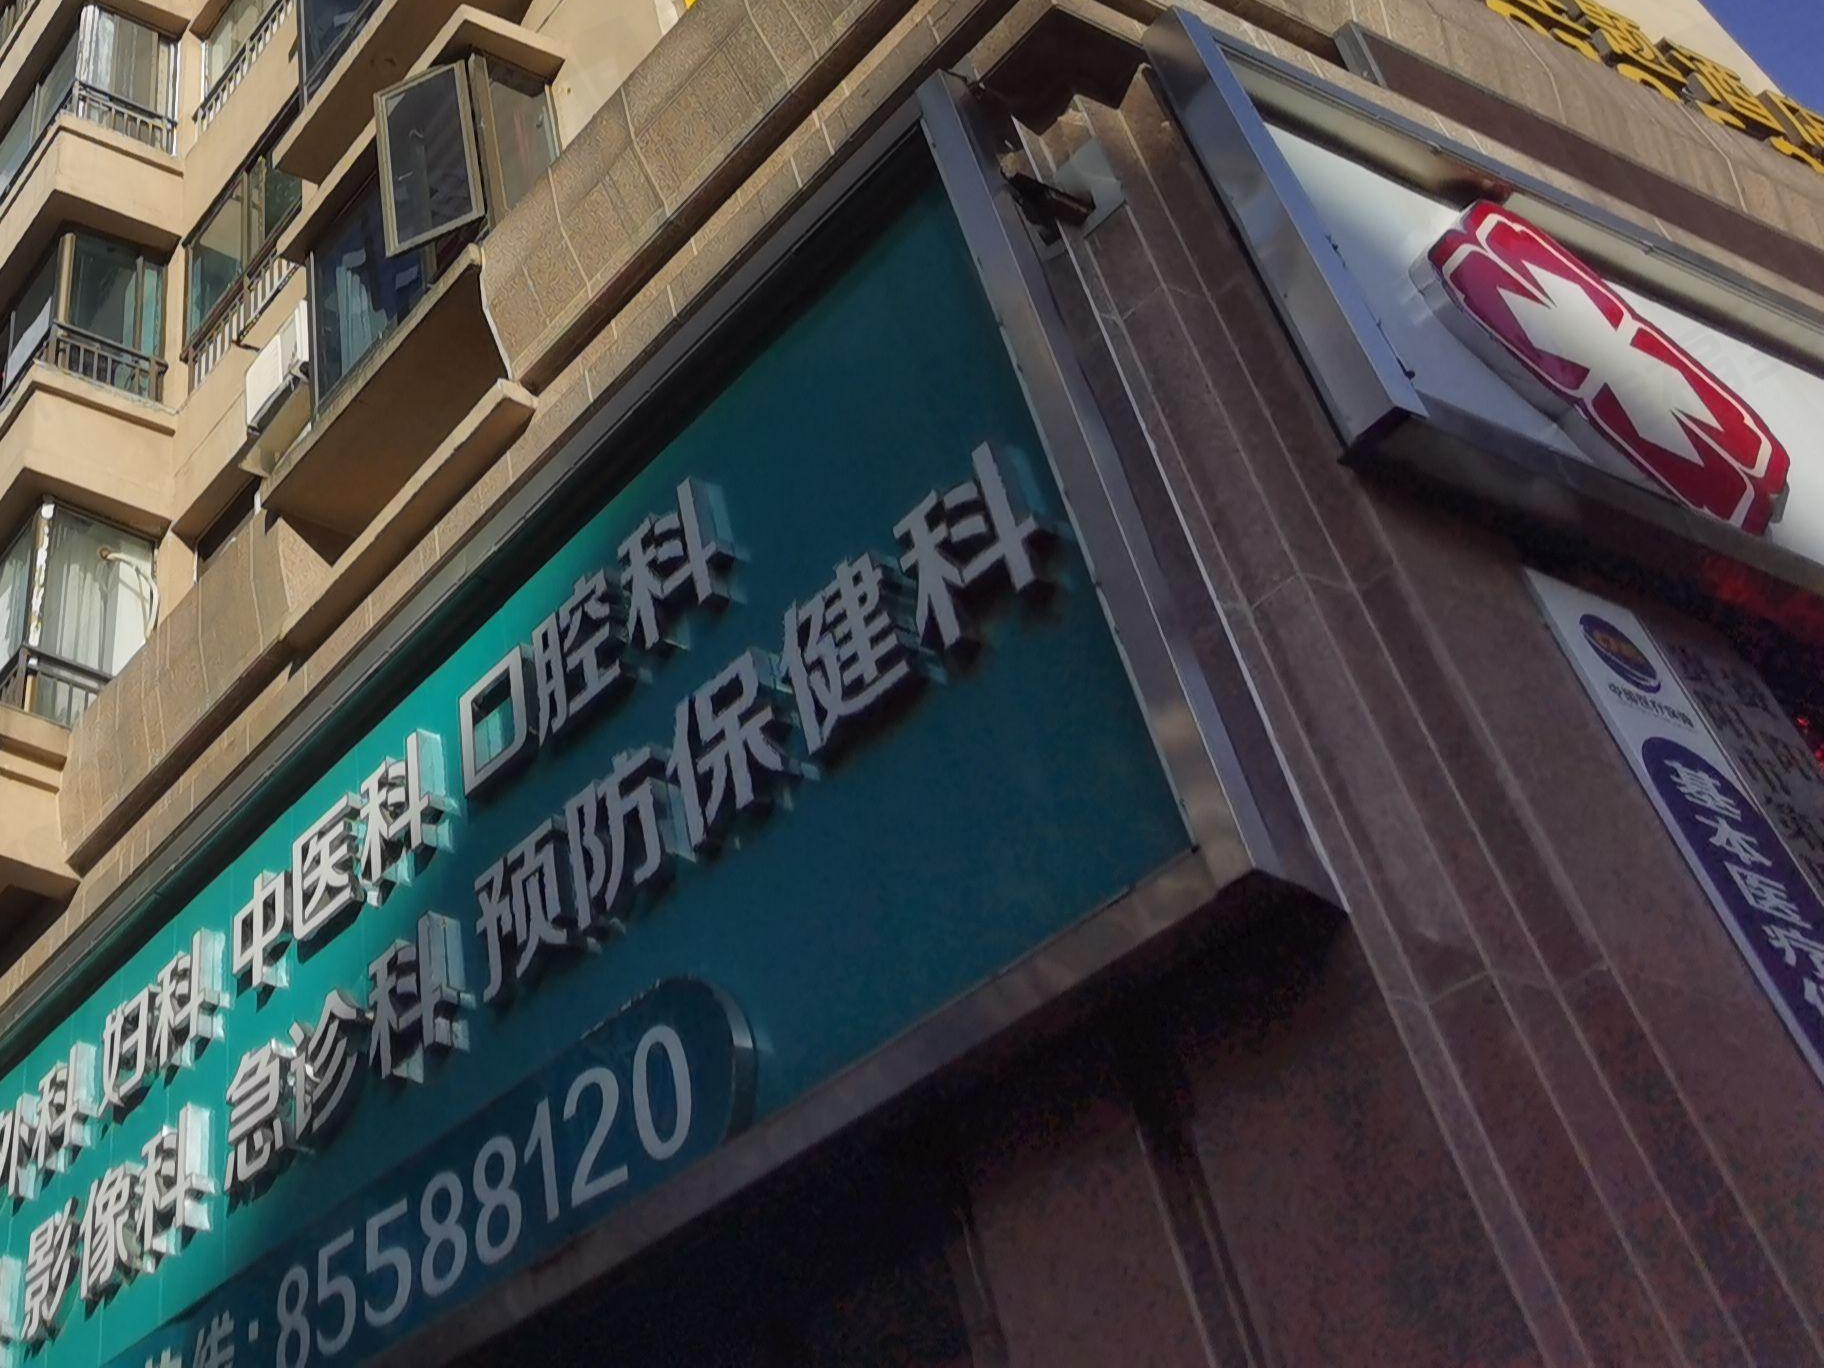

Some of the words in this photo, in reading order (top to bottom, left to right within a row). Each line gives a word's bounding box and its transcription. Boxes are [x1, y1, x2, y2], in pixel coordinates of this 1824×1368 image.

[21, 1102, 208, 1337] 影像科
[225, 912, 466, 1192] 急诊科
[474, 442, 1038, 1004] 预防保健科
[98, 929, 223, 1117] 妇科
[232, 730, 442, 989] 中医科
[459, 477, 721, 797] 口腔科
[1664, 756, 1824, 1020] 基本医疗
[277, 1025, 692, 1368] 85588120
